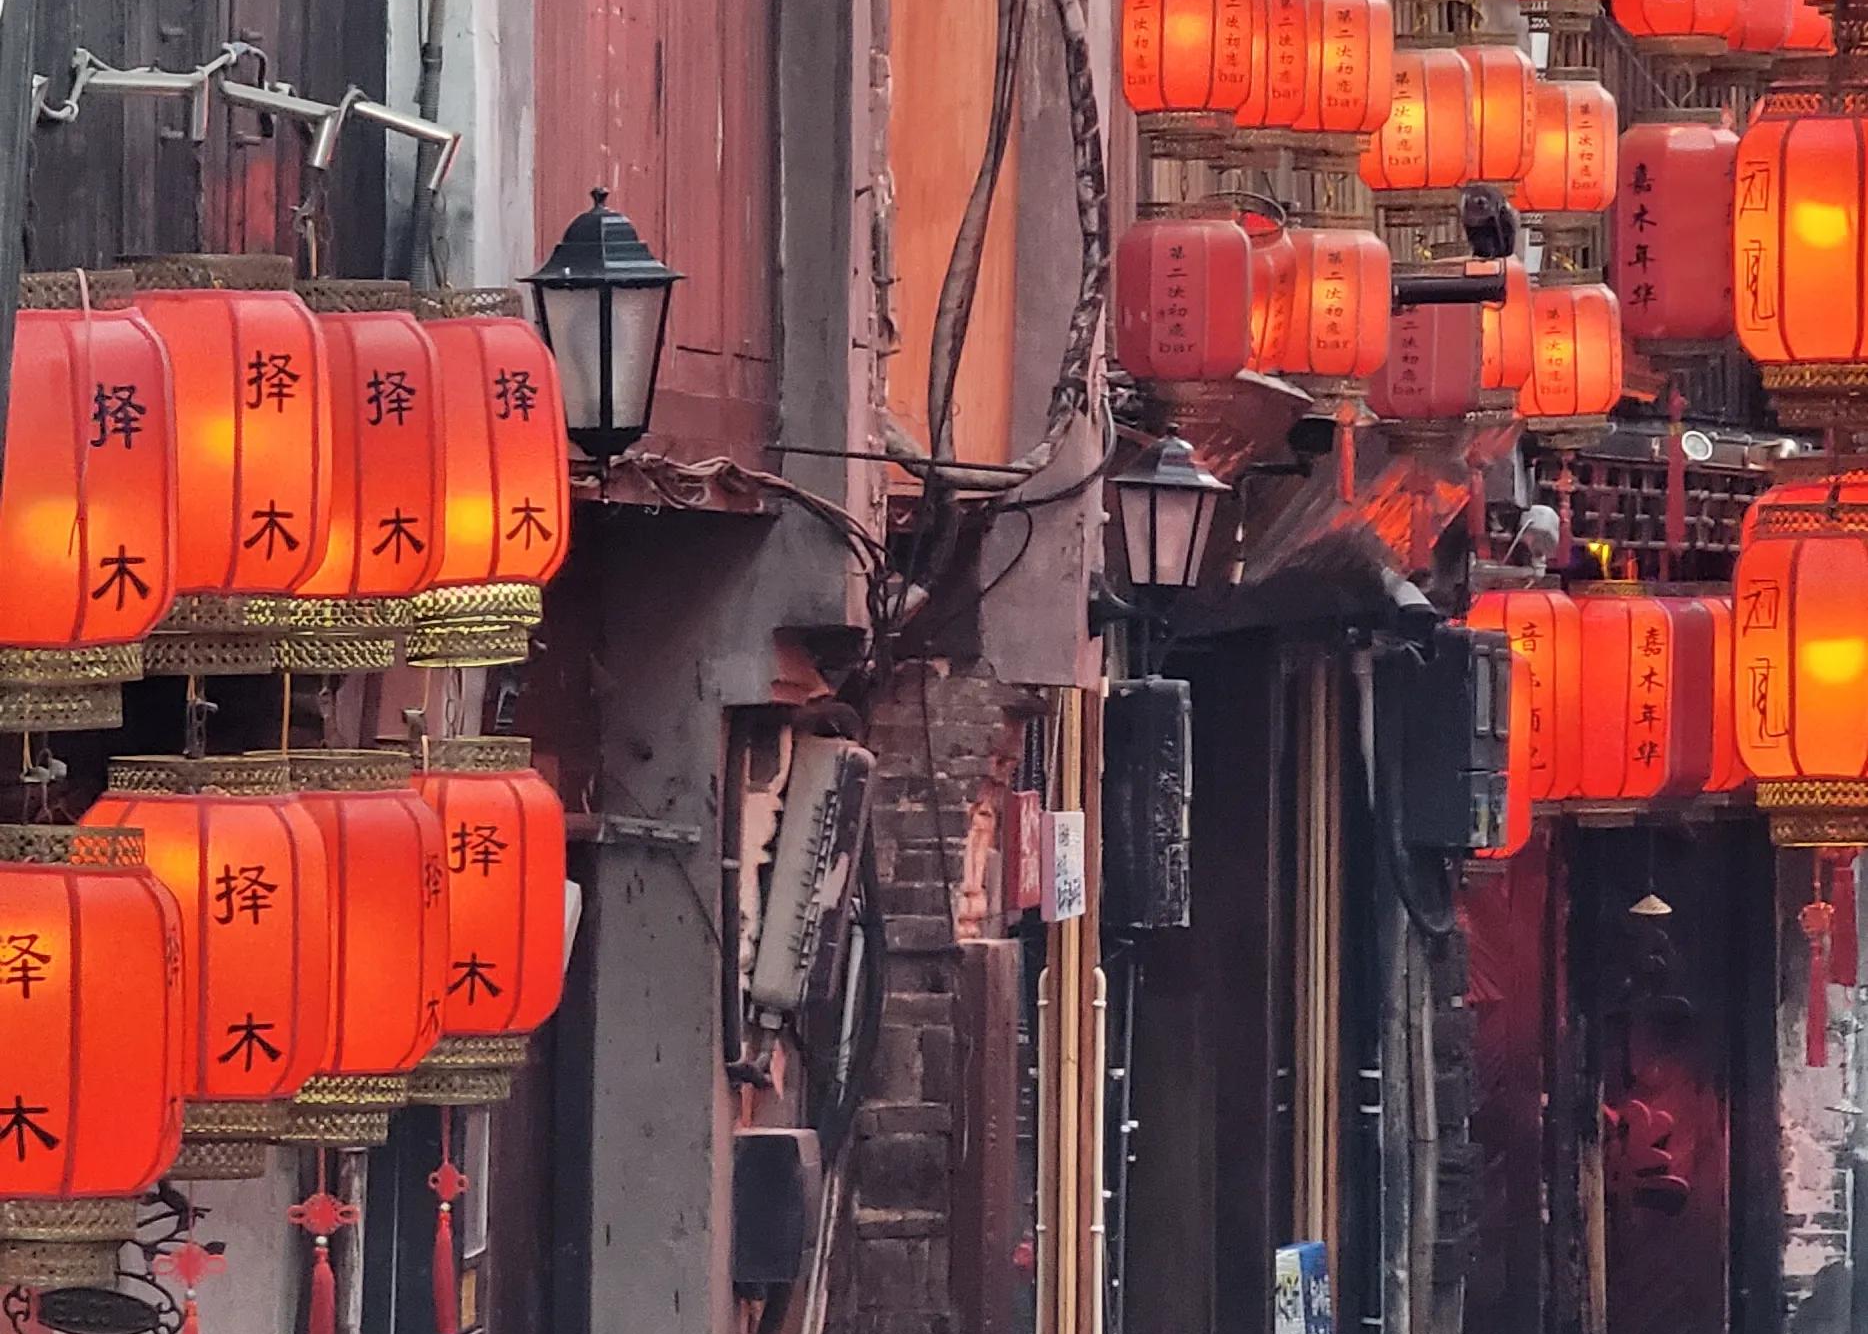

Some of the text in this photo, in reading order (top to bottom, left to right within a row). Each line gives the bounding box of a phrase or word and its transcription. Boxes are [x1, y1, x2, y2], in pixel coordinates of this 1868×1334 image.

[1127, 72, 1155, 86] bar
[1218, 71, 1246, 84] bar
[1272, 86, 1300, 99] bar
[1326, 95, 1361, 109] bar
[1388, 154, 1422, 166] bar
[1571, 178, 1599, 190] bar
[1627, 162, 1658, 313] 嘉木年华
[1158, 339, 1196, 354] bar
[1316, 337, 1352, 350] bar
[1392, 383, 1425, 397] bar
[1539, 383, 1569, 396] bar
[244, 350, 301, 562] 择木
[494, 367, 553, 551] 择木
[366, 369, 425, 565] 择木
[90, 383, 152, 612] 择木
[1632, 627, 1667, 769] 嘉木年华
[448, 821, 508, 1006] 择木
[214, 863, 282, 1073] 择木
